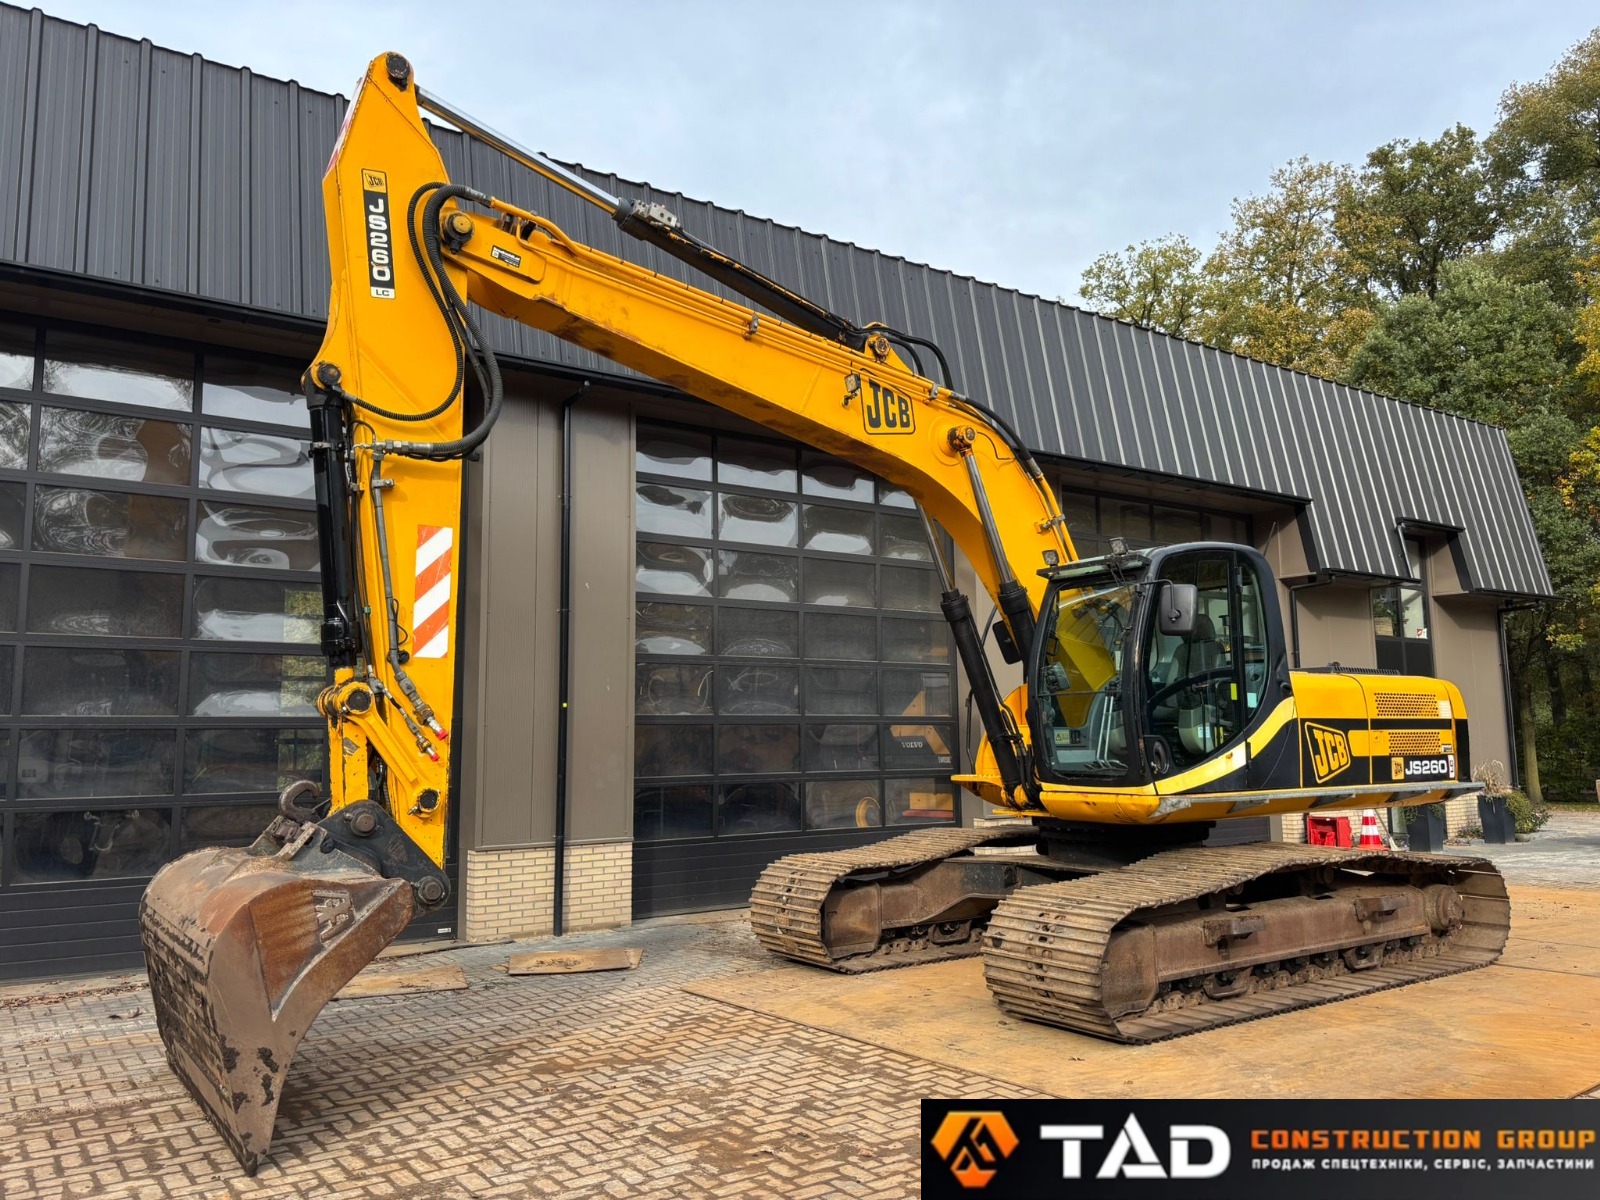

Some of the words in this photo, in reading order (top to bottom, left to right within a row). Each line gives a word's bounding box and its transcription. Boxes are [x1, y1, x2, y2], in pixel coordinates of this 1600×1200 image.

[368, 199, 391, 281] JS260
[867, 378, 910, 428] JCB
[1313, 729, 1348, 777] JCB
[1405, 760, 1448, 775] JS260
